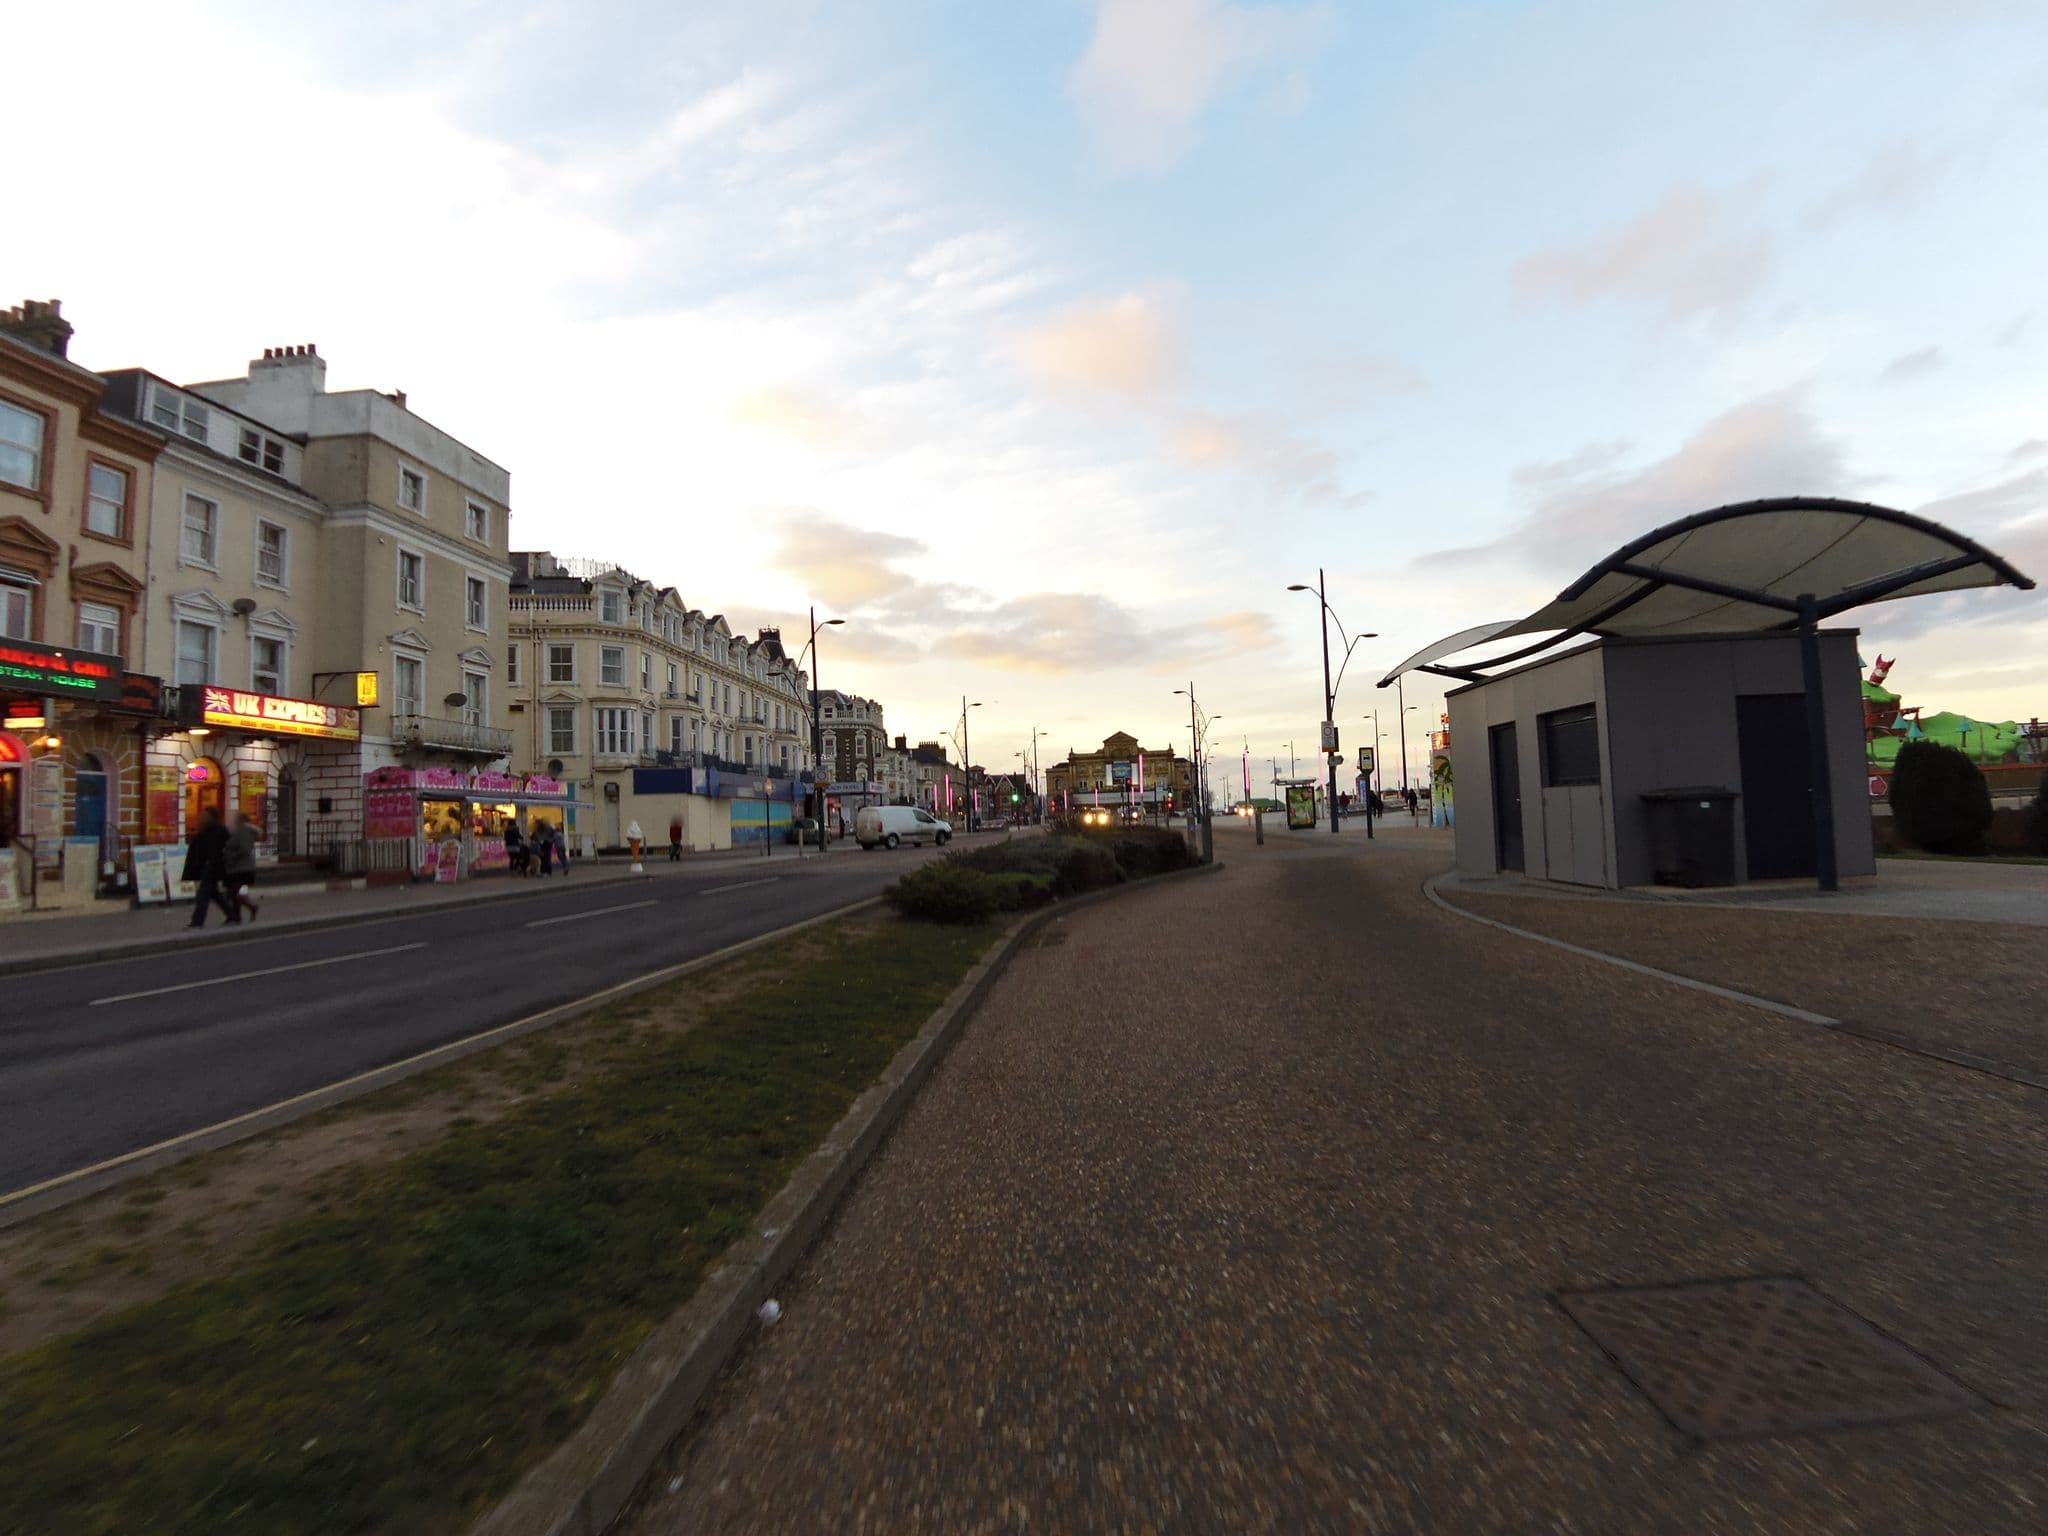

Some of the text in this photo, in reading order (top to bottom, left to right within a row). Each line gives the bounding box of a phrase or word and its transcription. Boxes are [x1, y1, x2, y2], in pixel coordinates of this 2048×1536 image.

[47, 675, 96, 688] HOUSE
[233, 693, 337, 726] UK EXPRESS
